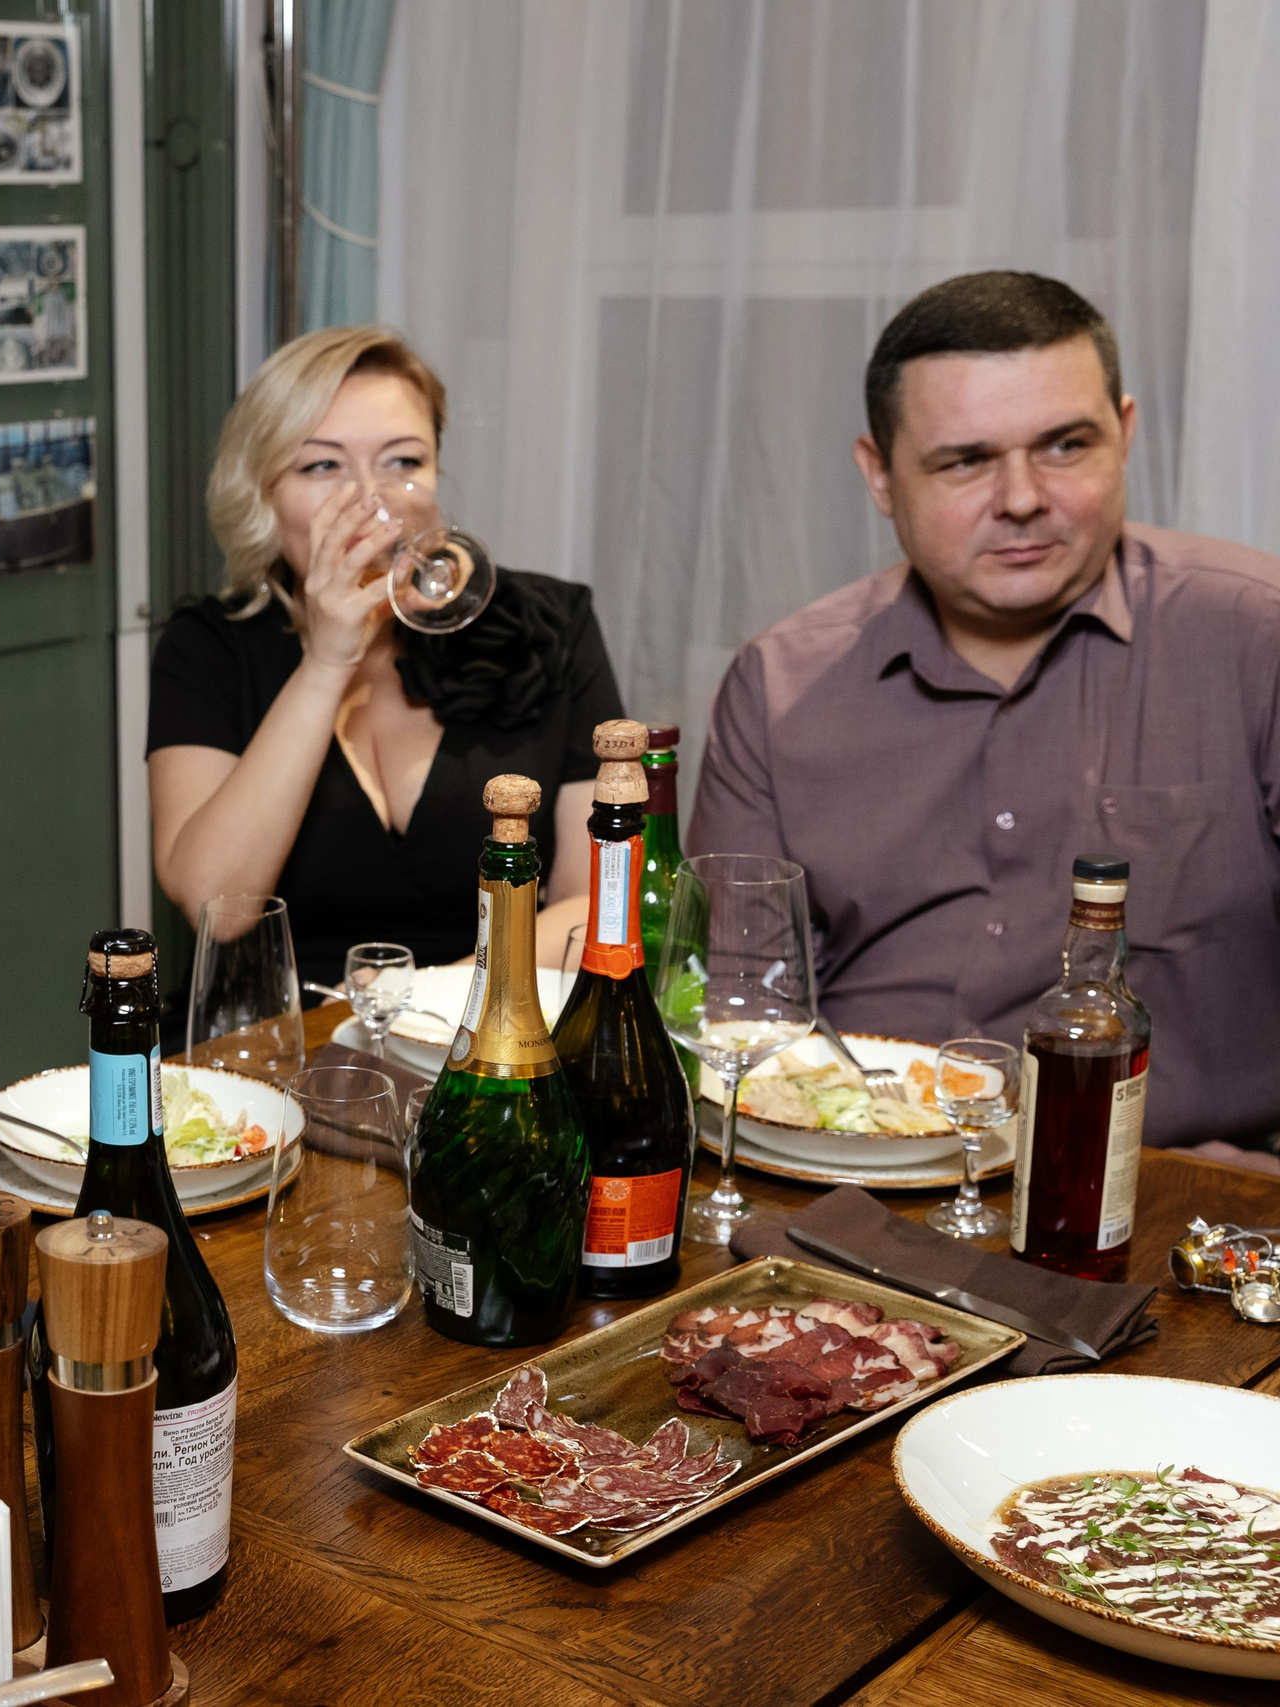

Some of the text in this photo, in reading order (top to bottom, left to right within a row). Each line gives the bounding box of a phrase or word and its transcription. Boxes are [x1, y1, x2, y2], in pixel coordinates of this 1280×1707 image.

[1116, 1086, 1124, 1101] 5
[181, 1422, 204, 1433] игристое
[206, 1416, 218, 1425] белое
[170, 1434, 188, 1442] Санта
[190, 1426, 213, 1438] Каролина
[174, 1440, 208, 1456] Регион
[178, 1455, 197, 1467] Год
[200, 1440, 226, 1463] урожая
[186, 1486, 212, 1500] ограничен
[173, 1497, 197, 1510] условий
